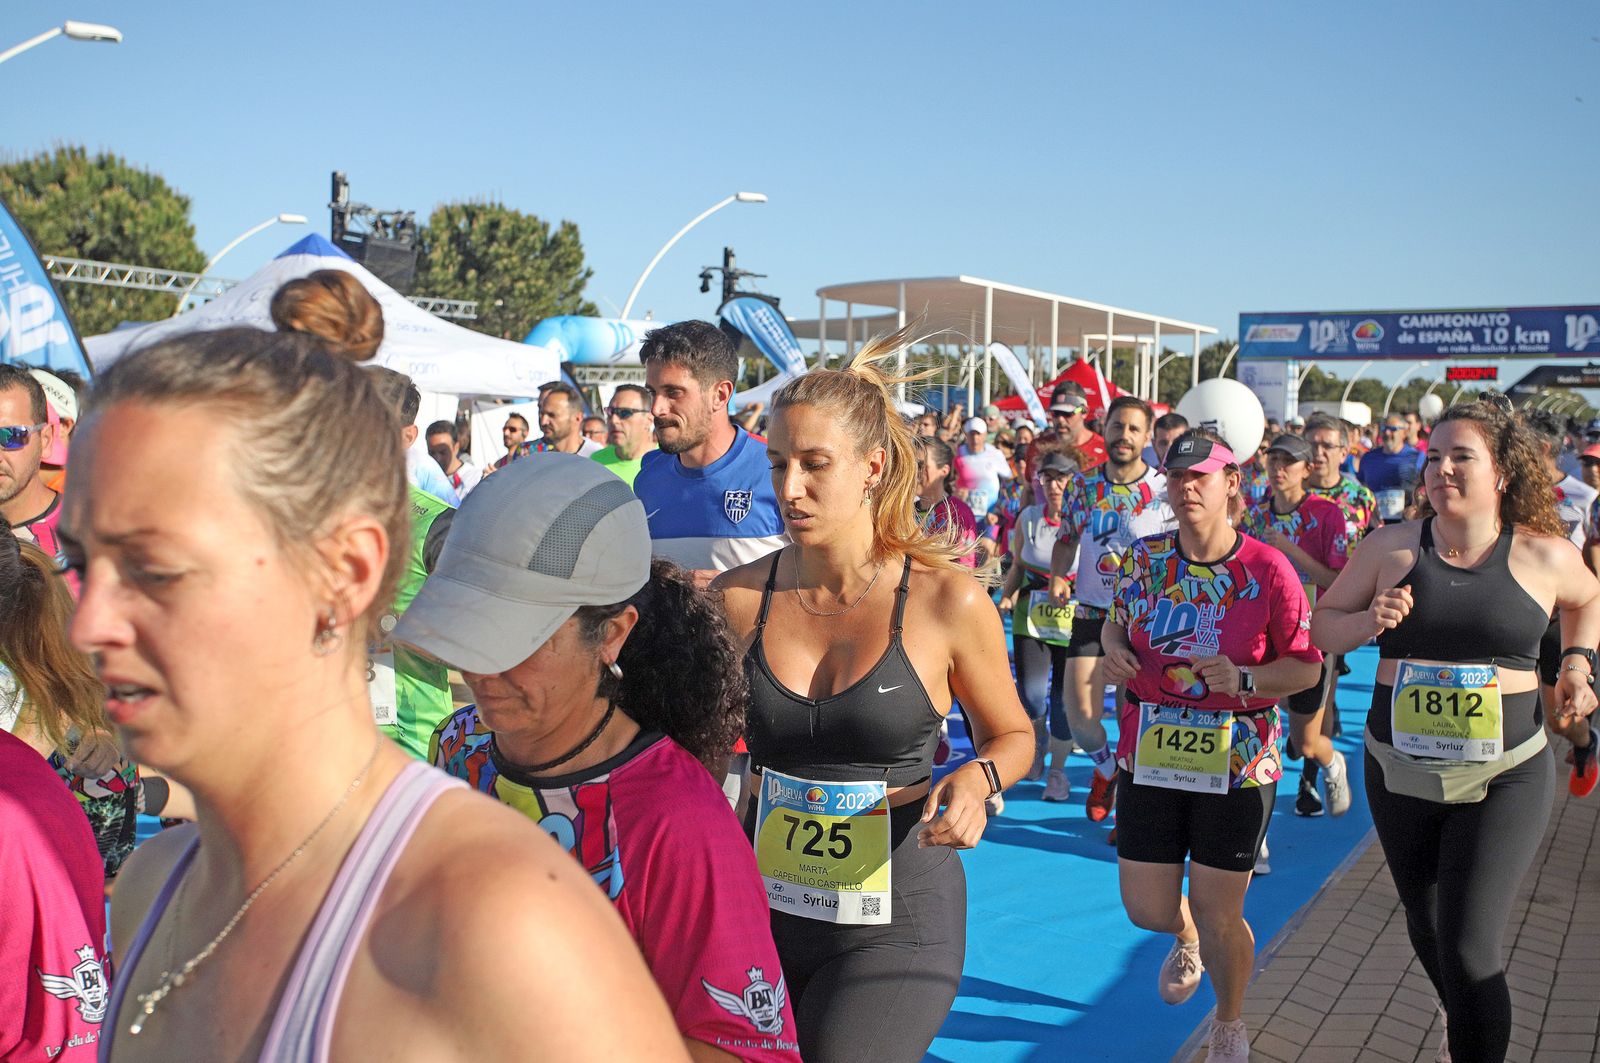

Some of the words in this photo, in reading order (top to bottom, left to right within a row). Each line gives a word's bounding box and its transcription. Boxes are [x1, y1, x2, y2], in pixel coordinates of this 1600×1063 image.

[1399, 313, 1511, 328] CAMPEONATO
[1397, 331, 1415, 344] de
[1418, 328, 1474, 343] ESPAÑA
[1483, 327, 1509, 345] 10
[1515, 325, 1550, 344] km
[1038, 603, 1071, 619] 1028
[1200, 603, 1225, 620] HU
[1199, 618, 1222, 634] EL
[1196, 630, 1219, 648] VA
[1460, 672, 1488, 685] 2023
[1409, 688, 1483, 717] 1812
[1153, 727, 1215, 755] 1425
[1435, 741, 1464, 752] Syrluz
[1174, 773, 1197, 784] Syrluz
[780, 786, 803, 802] HUELVA
[836, 793, 876, 811] 2023
[783, 814, 853, 860] 725
[799, 863, 829, 876] MARTA
[773, 869, 816, 886] CAPETILLO
[817, 877, 863, 891] CASTILLO
[803, 893, 839, 909] Syrluz
